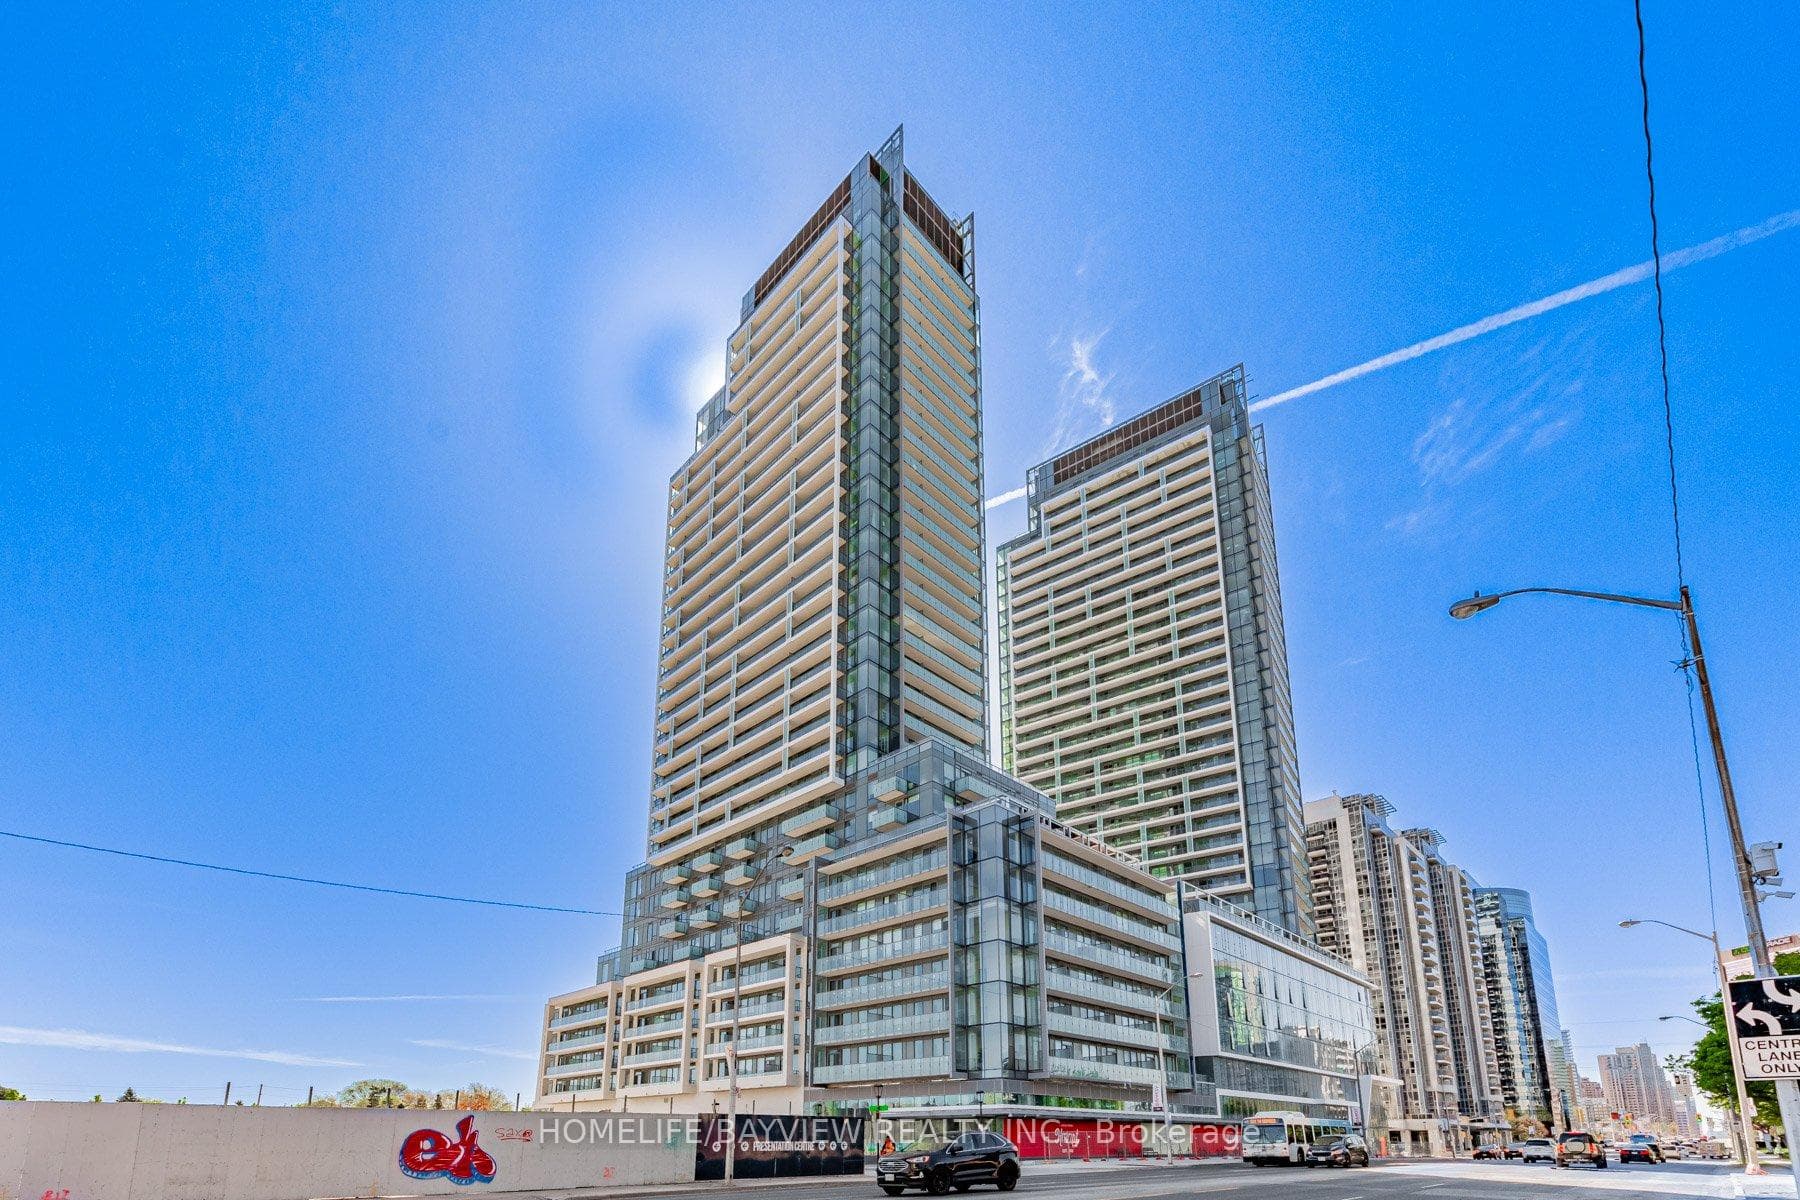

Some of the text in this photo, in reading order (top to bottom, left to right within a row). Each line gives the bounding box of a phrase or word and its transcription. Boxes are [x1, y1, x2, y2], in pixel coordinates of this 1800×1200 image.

[1758, 1051, 1800, 1061] LANE
[1761, 1063, 1800, 1073] ONLY
[753, 1141, 794, 1152] PRESENTATION
